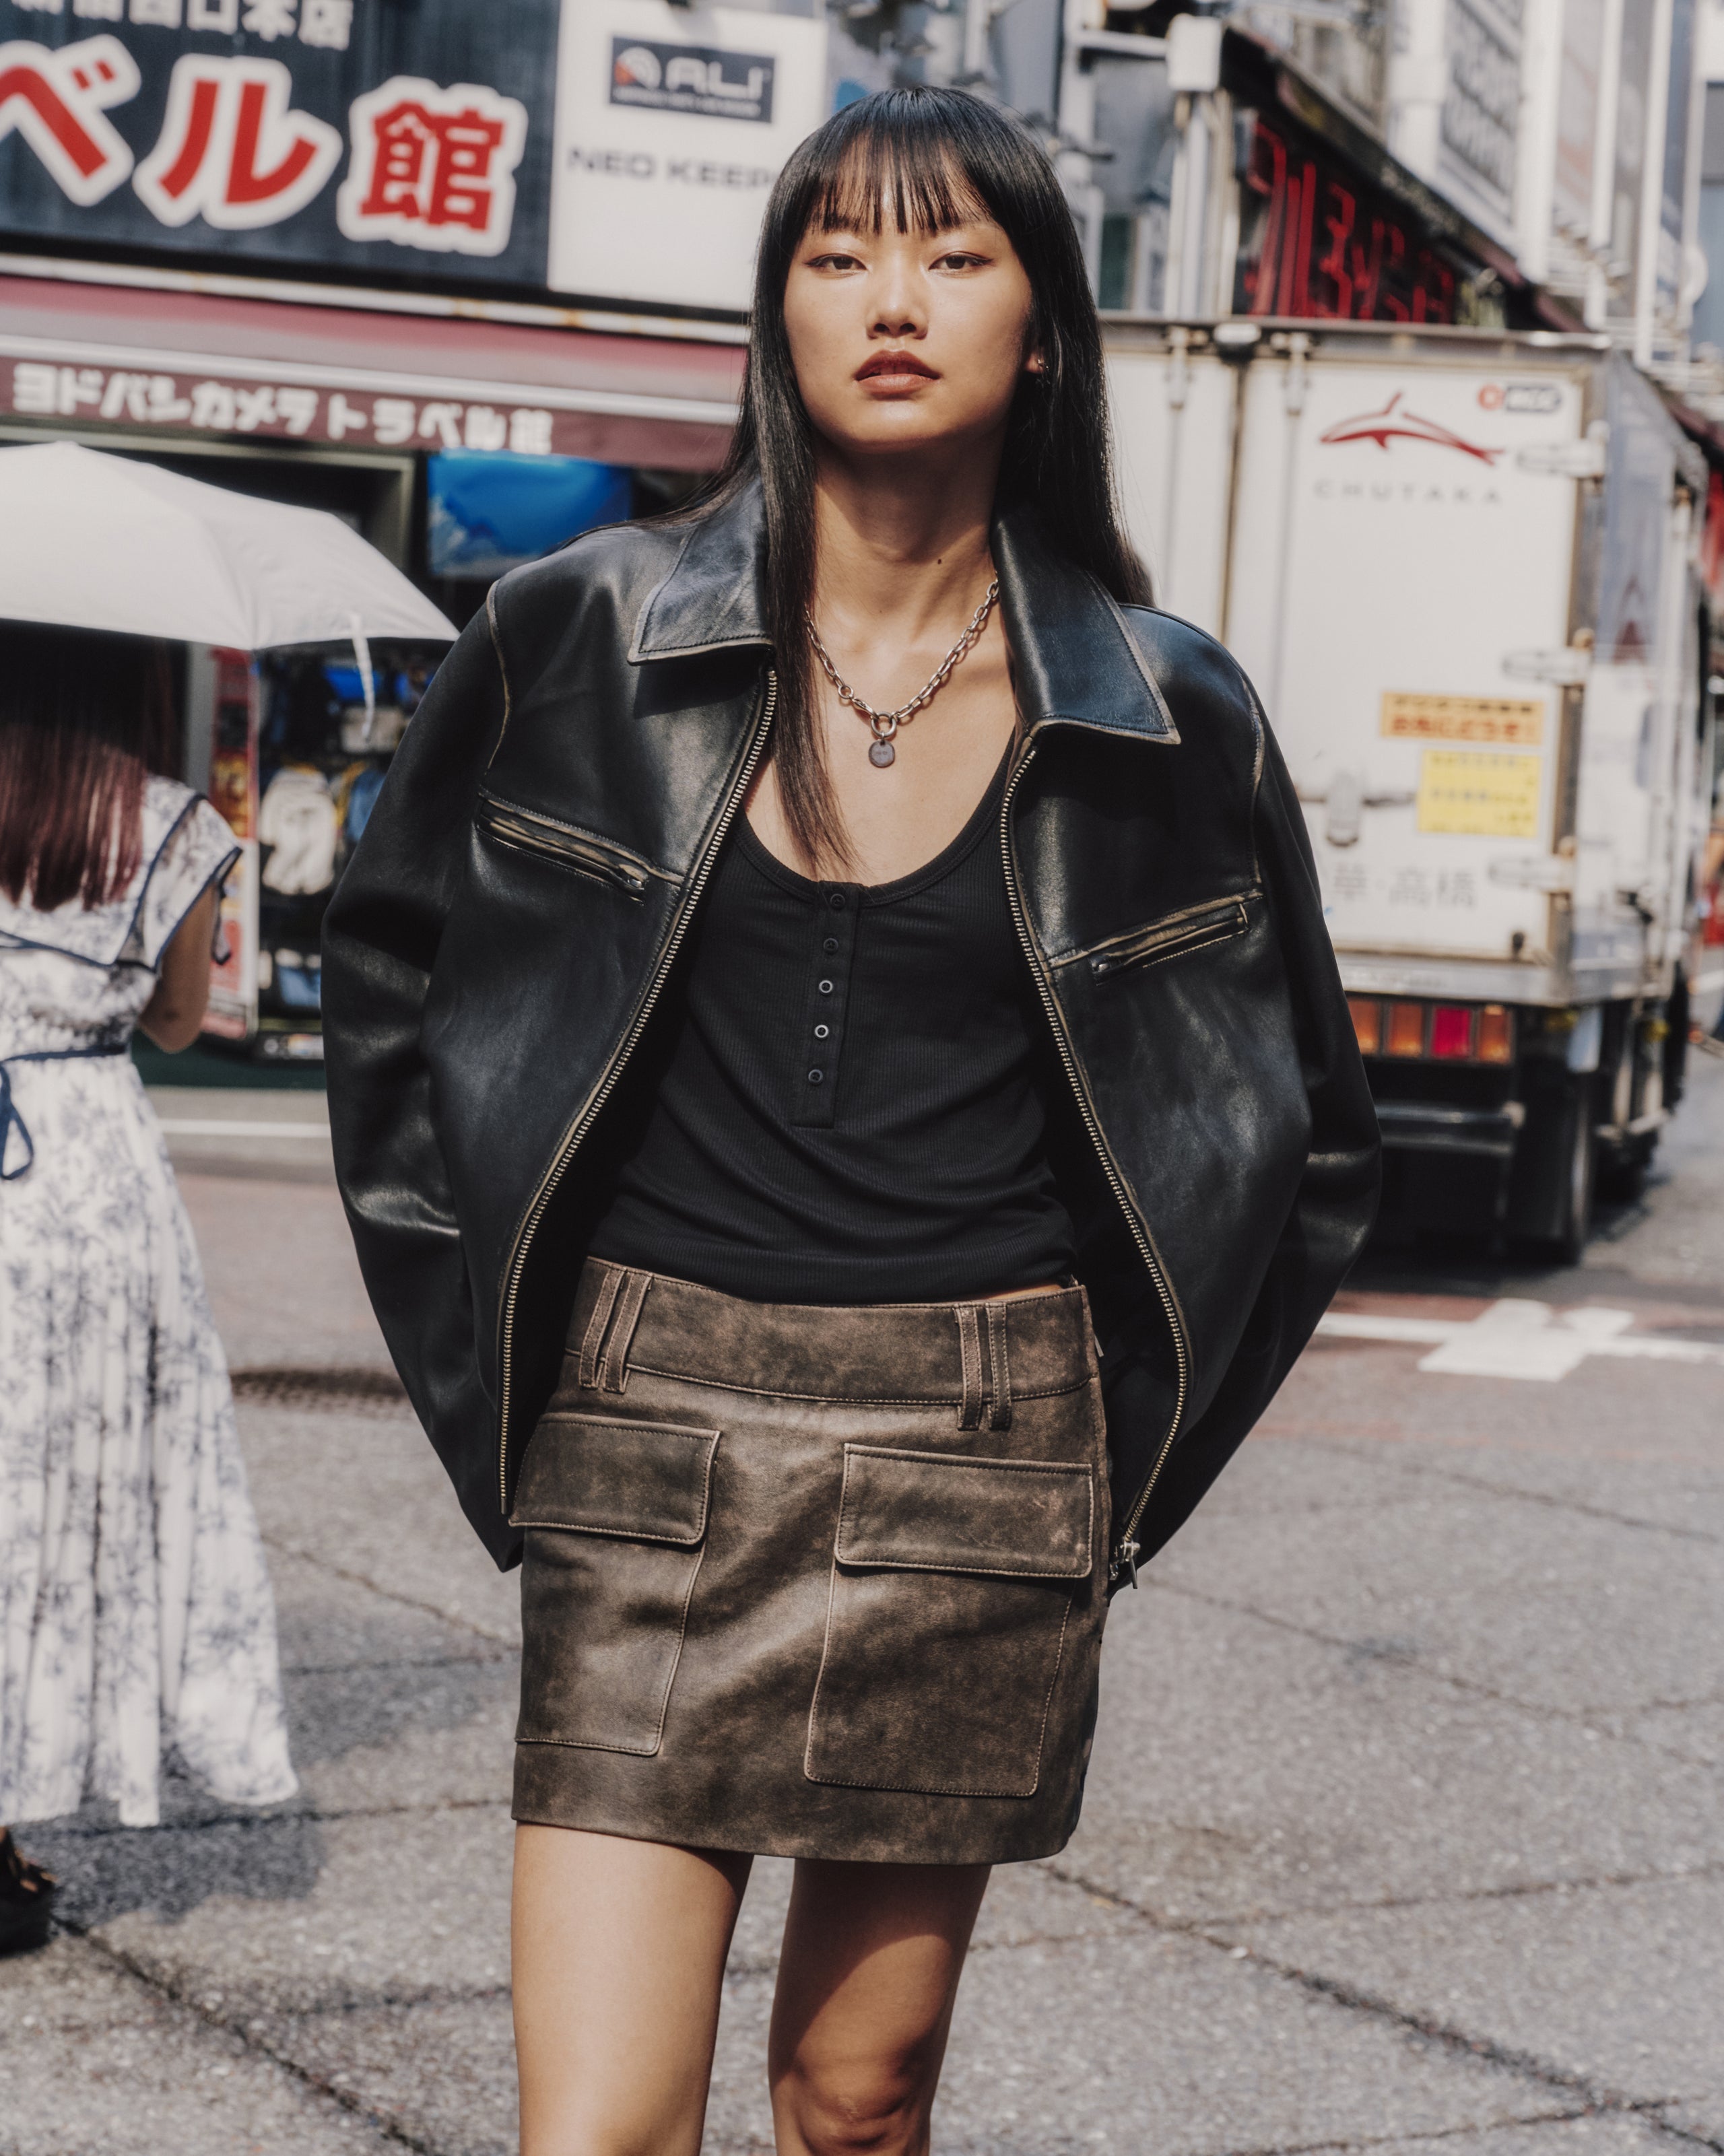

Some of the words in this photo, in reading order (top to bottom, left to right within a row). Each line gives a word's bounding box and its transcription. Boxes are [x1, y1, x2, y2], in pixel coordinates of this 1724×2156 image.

[0, 39, 524, 252] ベル館
[568, 148, 657, 180] NEO
[13, 362, 319, 437] ヨドバシカメラ
